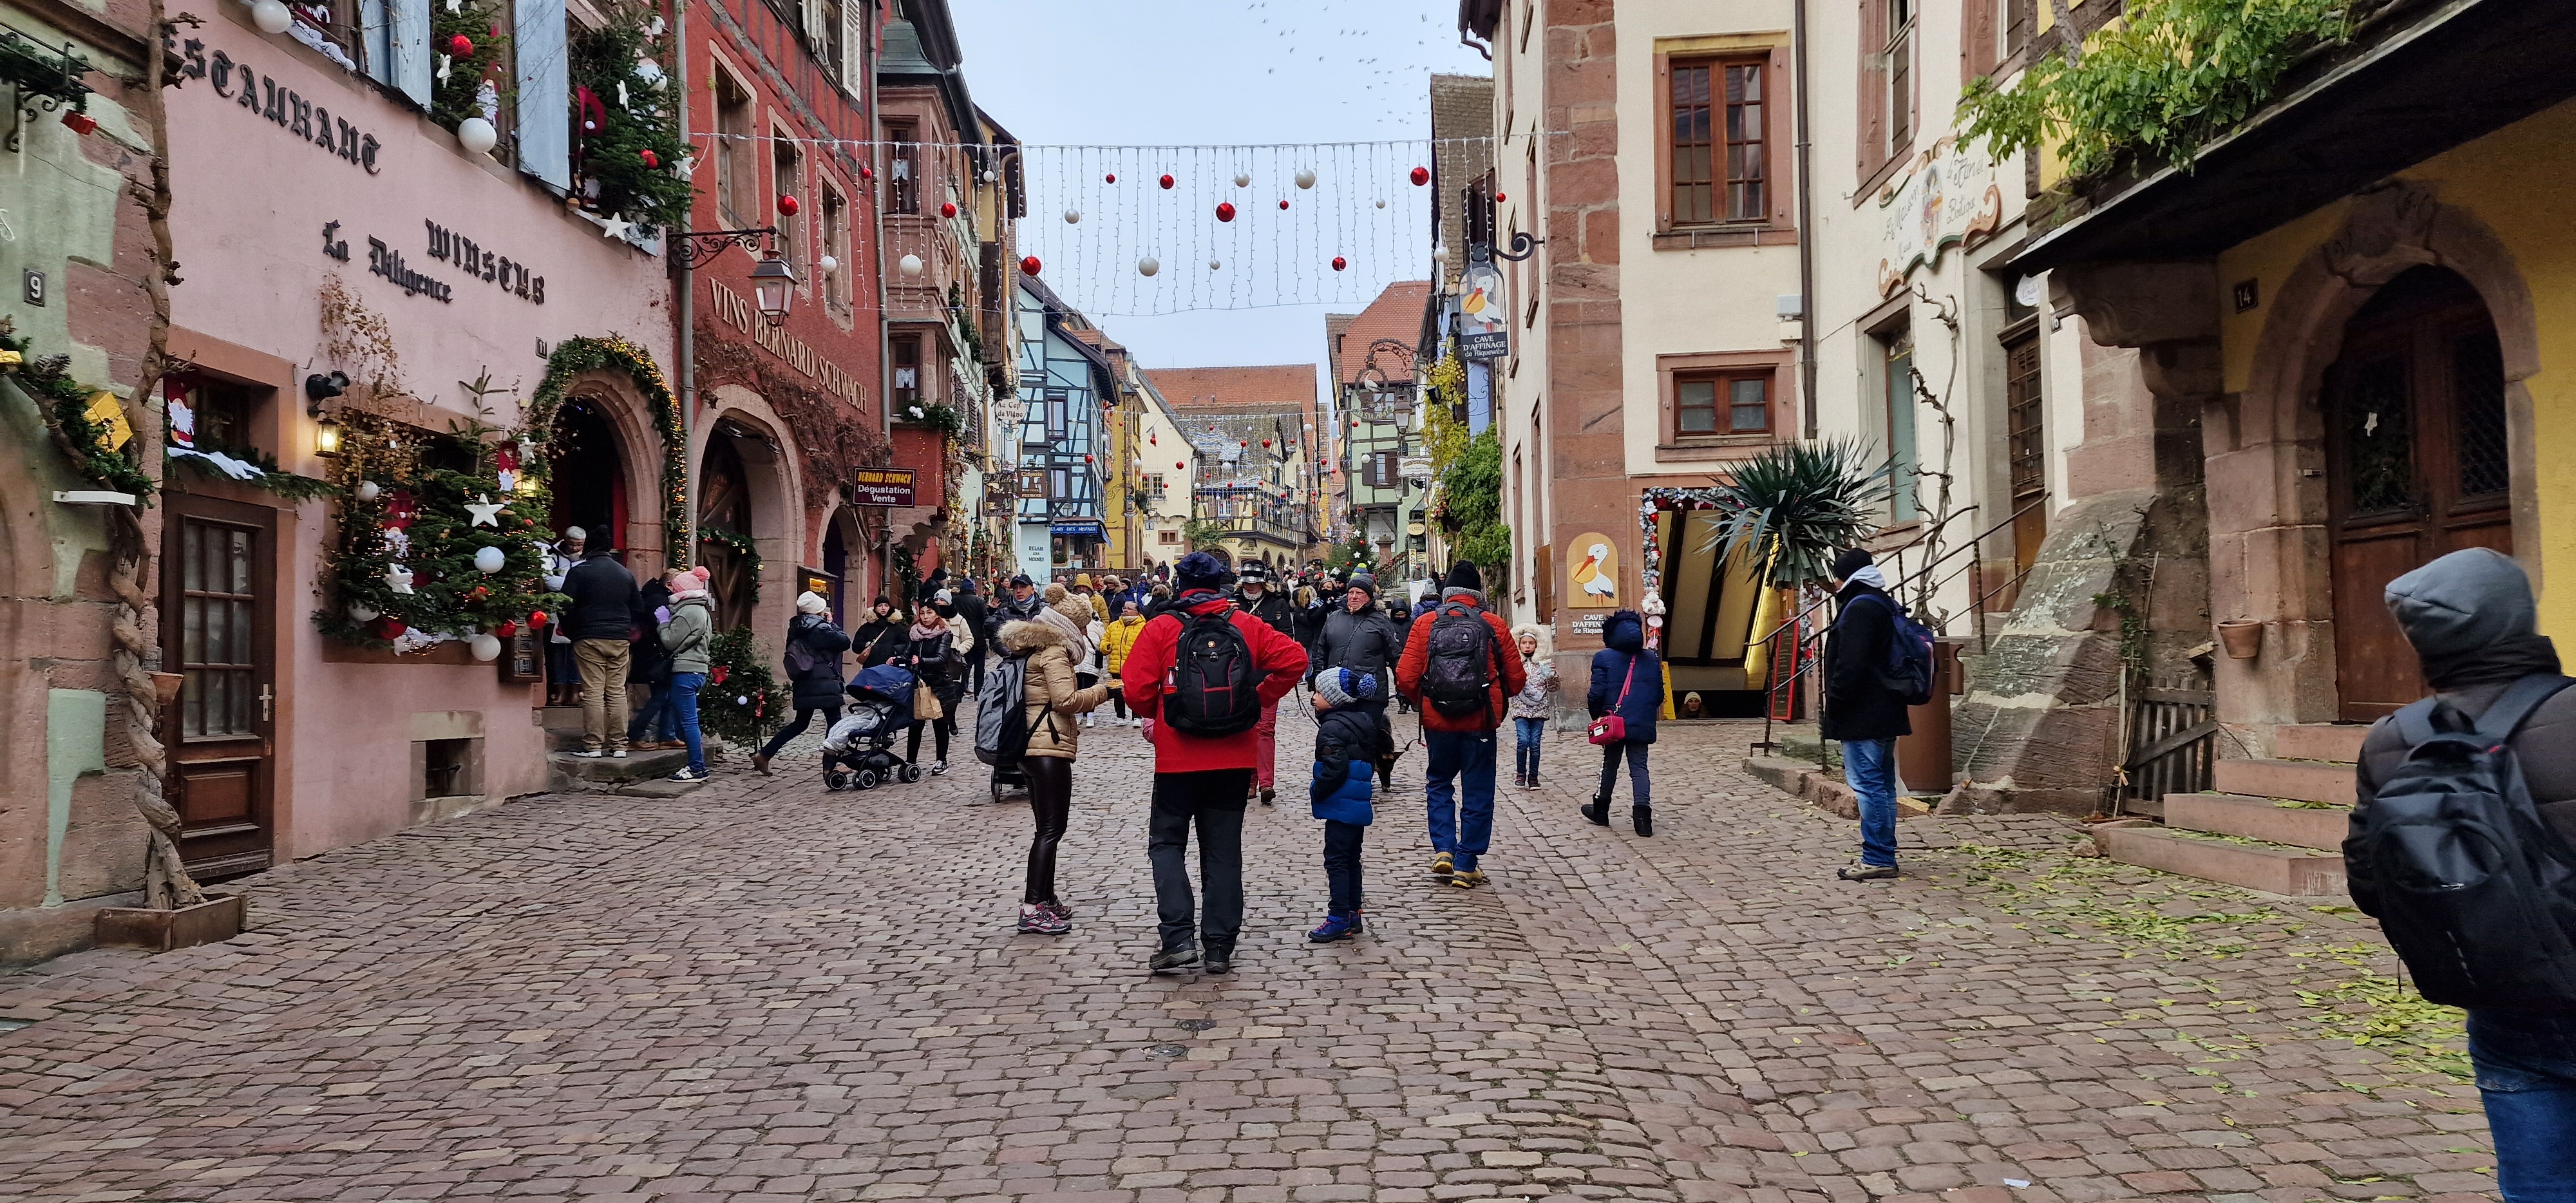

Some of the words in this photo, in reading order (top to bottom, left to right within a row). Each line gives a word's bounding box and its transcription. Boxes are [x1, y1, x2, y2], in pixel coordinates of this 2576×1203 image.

[322, 219, 351, 263] La
[368, 233, 453, 304] Diligence
[30, 276, 41, 299] 9
[2237, 287, 2251, 307] 14
[1474, 335, 1495, 343] CAVE
[708, 276, 747, 334] VINS
[754, 308, 816, 378] BERNARD
[818, 355, 867, 415] SCHWACH
[1463, 341, 1507, 351] D'AFFINAGE
[1474, 348, 1506, 357] Riquewihr
[857, 471, 884, 483] BERNARD
[884, 473, 913, 484] SCHWACH
[858, 484, 911, 495] Dégustation
[871, 494, 896, 503] Vente
